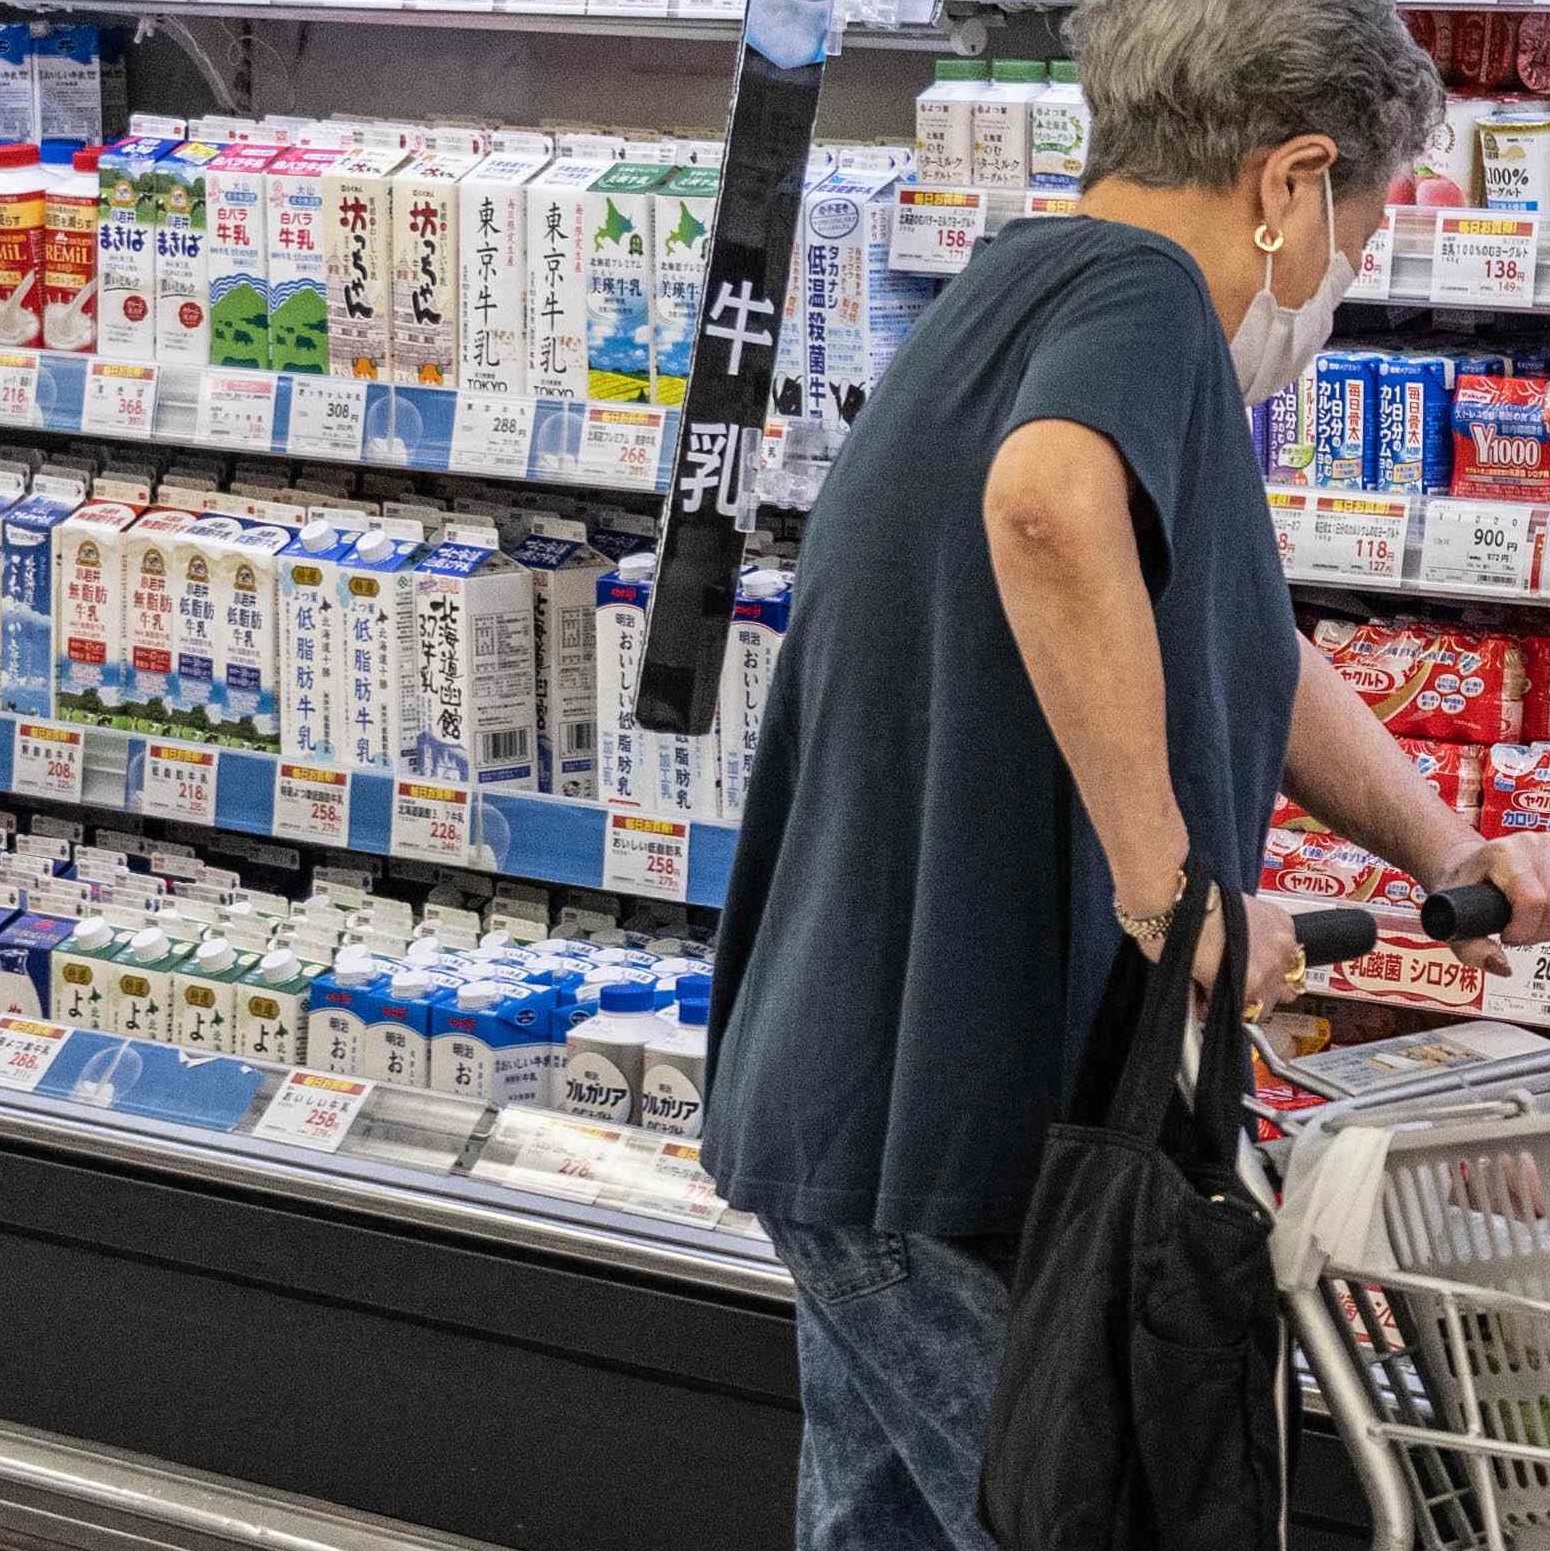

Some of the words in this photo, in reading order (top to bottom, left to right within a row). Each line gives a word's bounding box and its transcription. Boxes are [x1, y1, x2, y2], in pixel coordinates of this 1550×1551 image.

[216, 208, 248, 223] 白バラ
[280, 212, 312, 226] 白バラ
[216, 224, 250, 246] 牛乳
[1484, 260, 1525, 279] 138円
[473, 195, 502, 370] 東京牛乳
[540, 201, 569, 376] 東京牛乳
[679, 280, 777, 517] 牛乳
[1473, 423, 1541, 466] Y1000
[1356, 541, 1395, 560] 118円
[1474, 529, 1518, 552] 900円
[68, 583, 107, 606] 無脂肪
[132, 589, 173, 612] 無脂肪
[178, 596, 215, 620] 低脂肪
[226, 605, 263, 630] 低脂肪
[295, 606, 316, 752] 低脂肪牛乳
[352, 616, 375, 765] 低脂肪牛乳
[1286, 874, 1340, 894] ヤクルト
[1349, 951, 1402, 983] 乳酸菌
[1410, 960, 1480, 993] シロタ株
